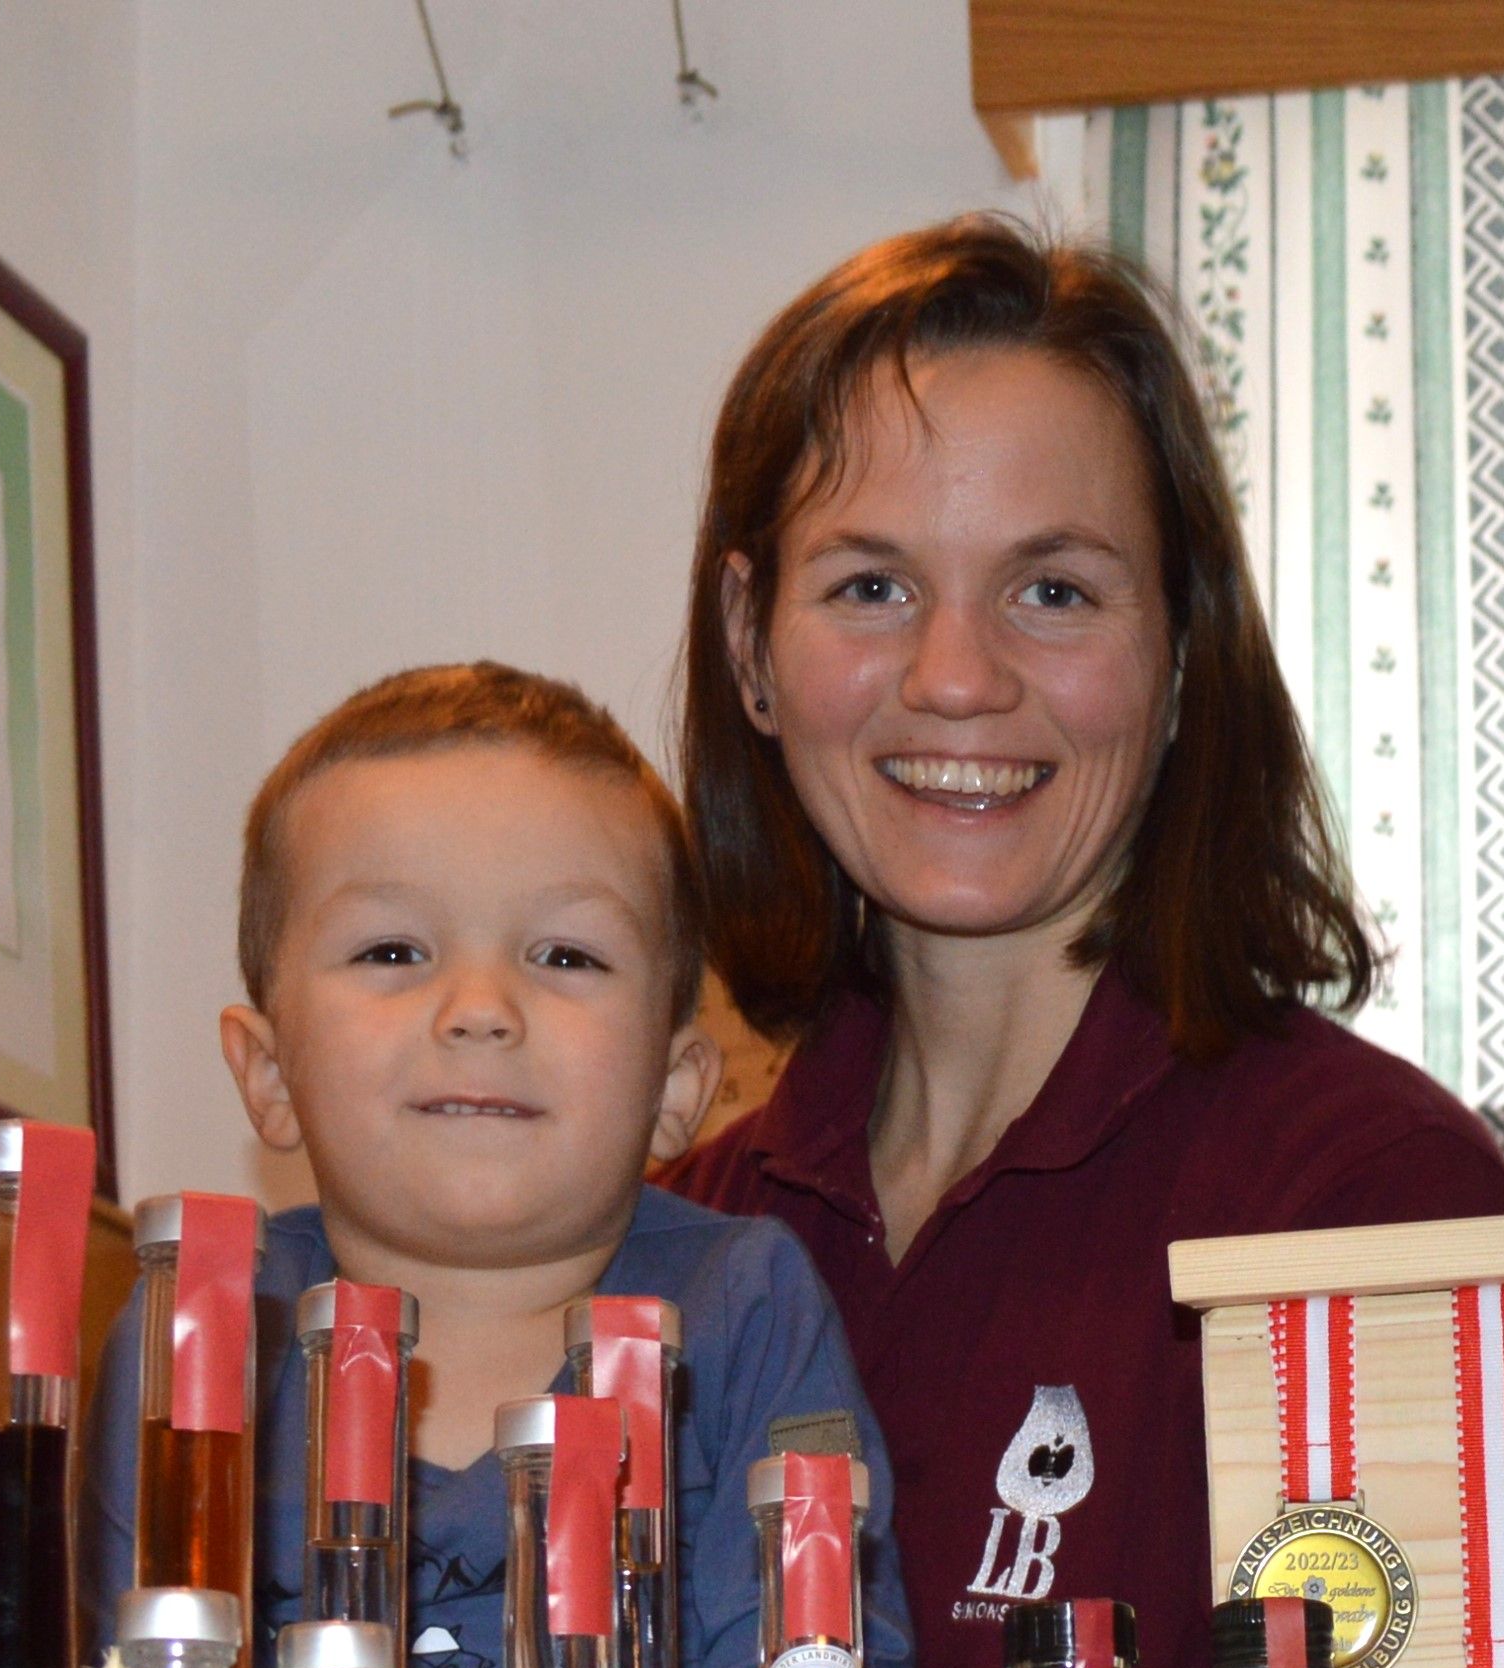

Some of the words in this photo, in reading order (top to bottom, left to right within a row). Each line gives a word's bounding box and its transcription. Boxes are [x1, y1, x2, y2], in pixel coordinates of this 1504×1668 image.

[967, 1507, 1061, 1599] LB
[1241, 1512, 1402, 1576] AUSZEICHNUNG
[1285, 1551, 1360, 1571] 2022/23
